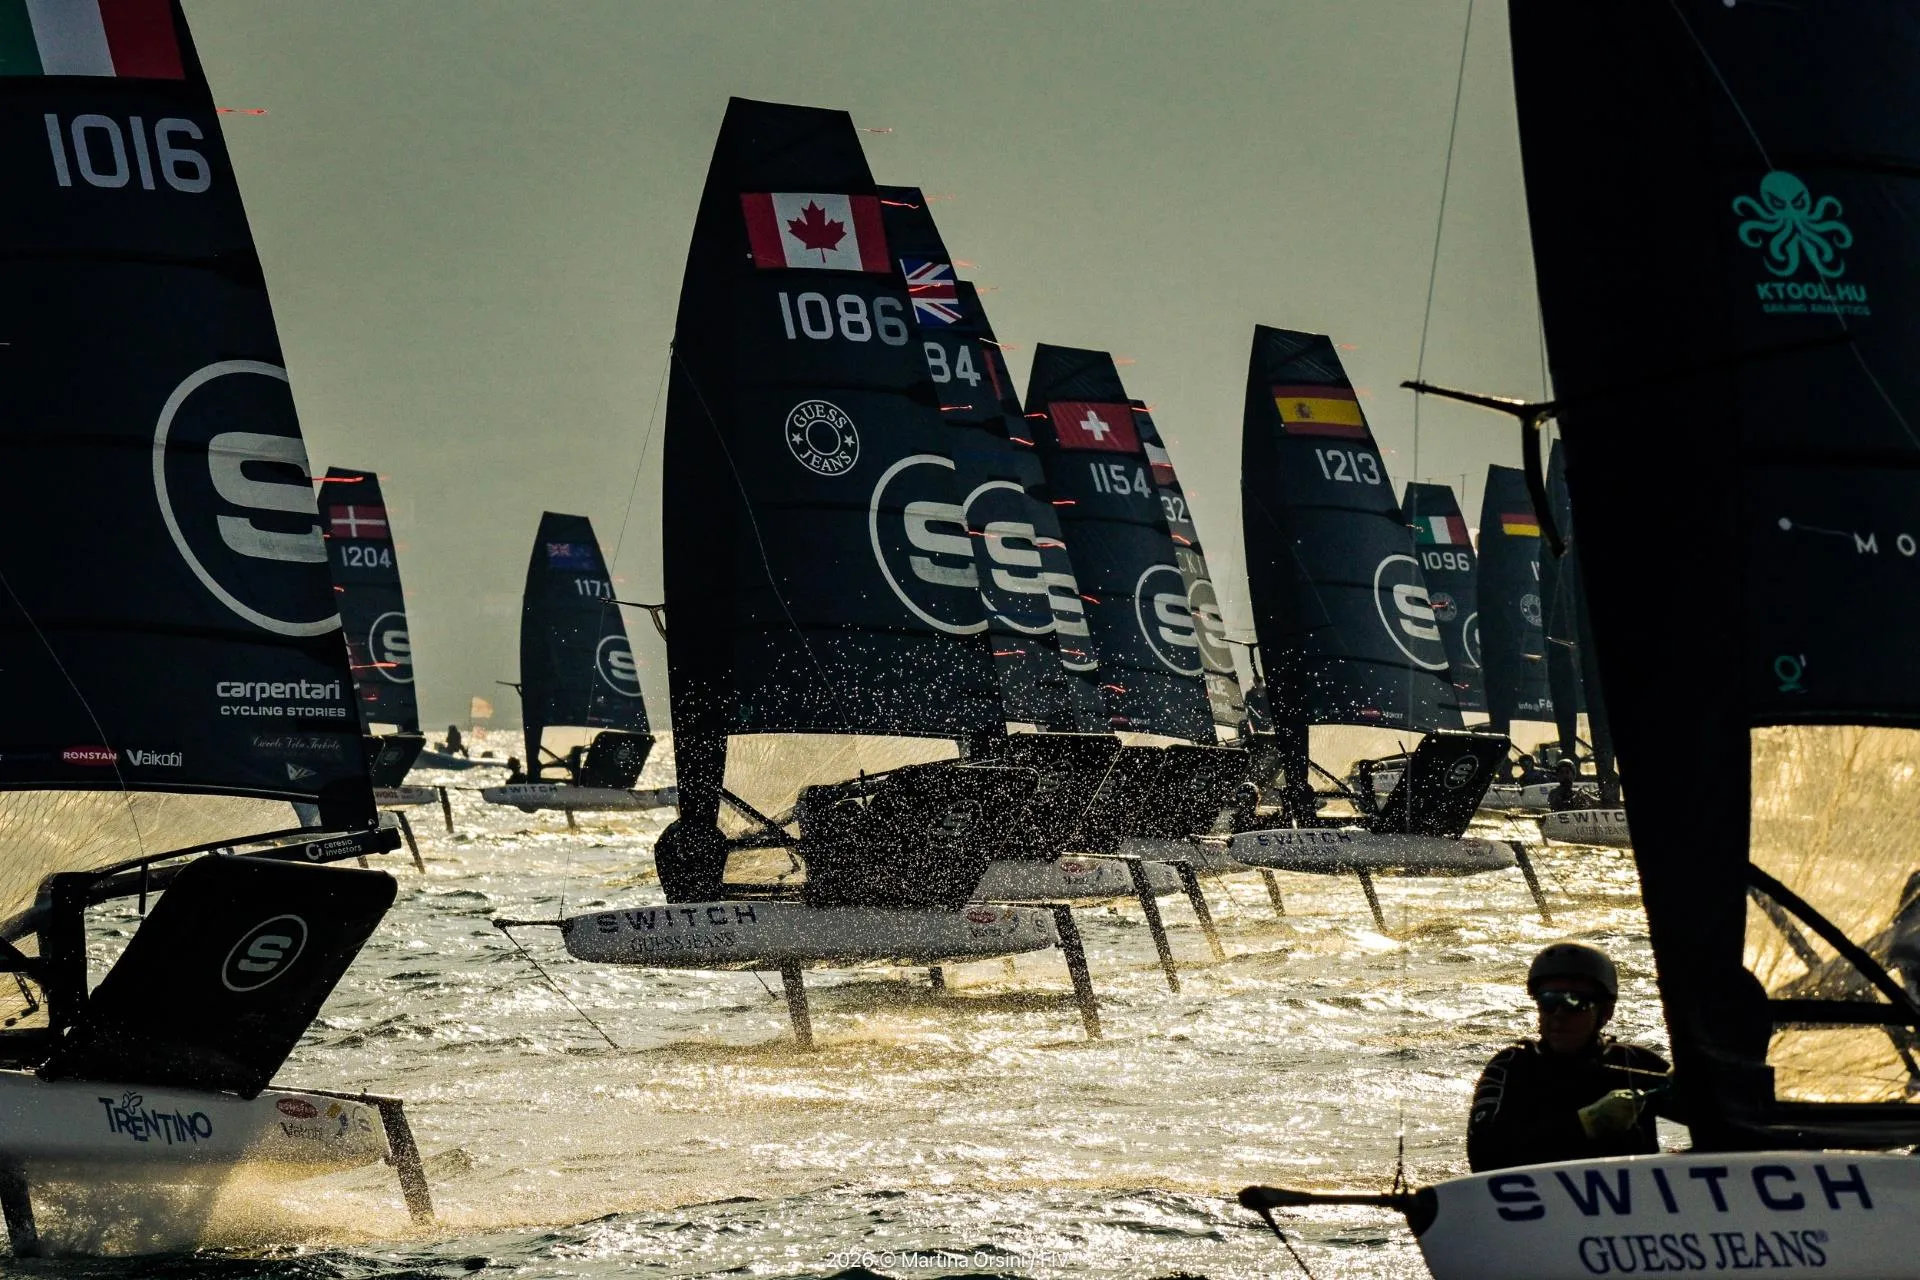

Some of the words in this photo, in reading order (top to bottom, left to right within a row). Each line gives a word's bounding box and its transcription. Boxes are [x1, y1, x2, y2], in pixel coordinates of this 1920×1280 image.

[44, 113, 212, 194] 1016
[1755, 281, 1868, 302] KTOOL.HU
[778, 291, 909, 347] 1086
[793, 404, 847, 430] GUESS
[800, 450, 852, 473] JEANS
[1315, 448, 1381, 486] 1213
[1089, 462, 1152, 499] 1154
[341, 545, 393, 568] 1204
[1421, 551, 1470, 572] 1096
[574, 578, 611, 599] 1171
[216, 679, 341, 702] carpentari
[220, 705, 283, 717] CYCLING
[286, 706, 347, 718] STORIES
[62, 750, 118, 761] RONSTAN
[125, 749, 183, 768] Vaikobi
[1558, 811, 1626, 824] SWITC
[596, 904, 757, 934] SWITCH
[1487, 1163, 1874, 1223] SWITCH
[1578, 1231, 1707, 1275] GUESS
